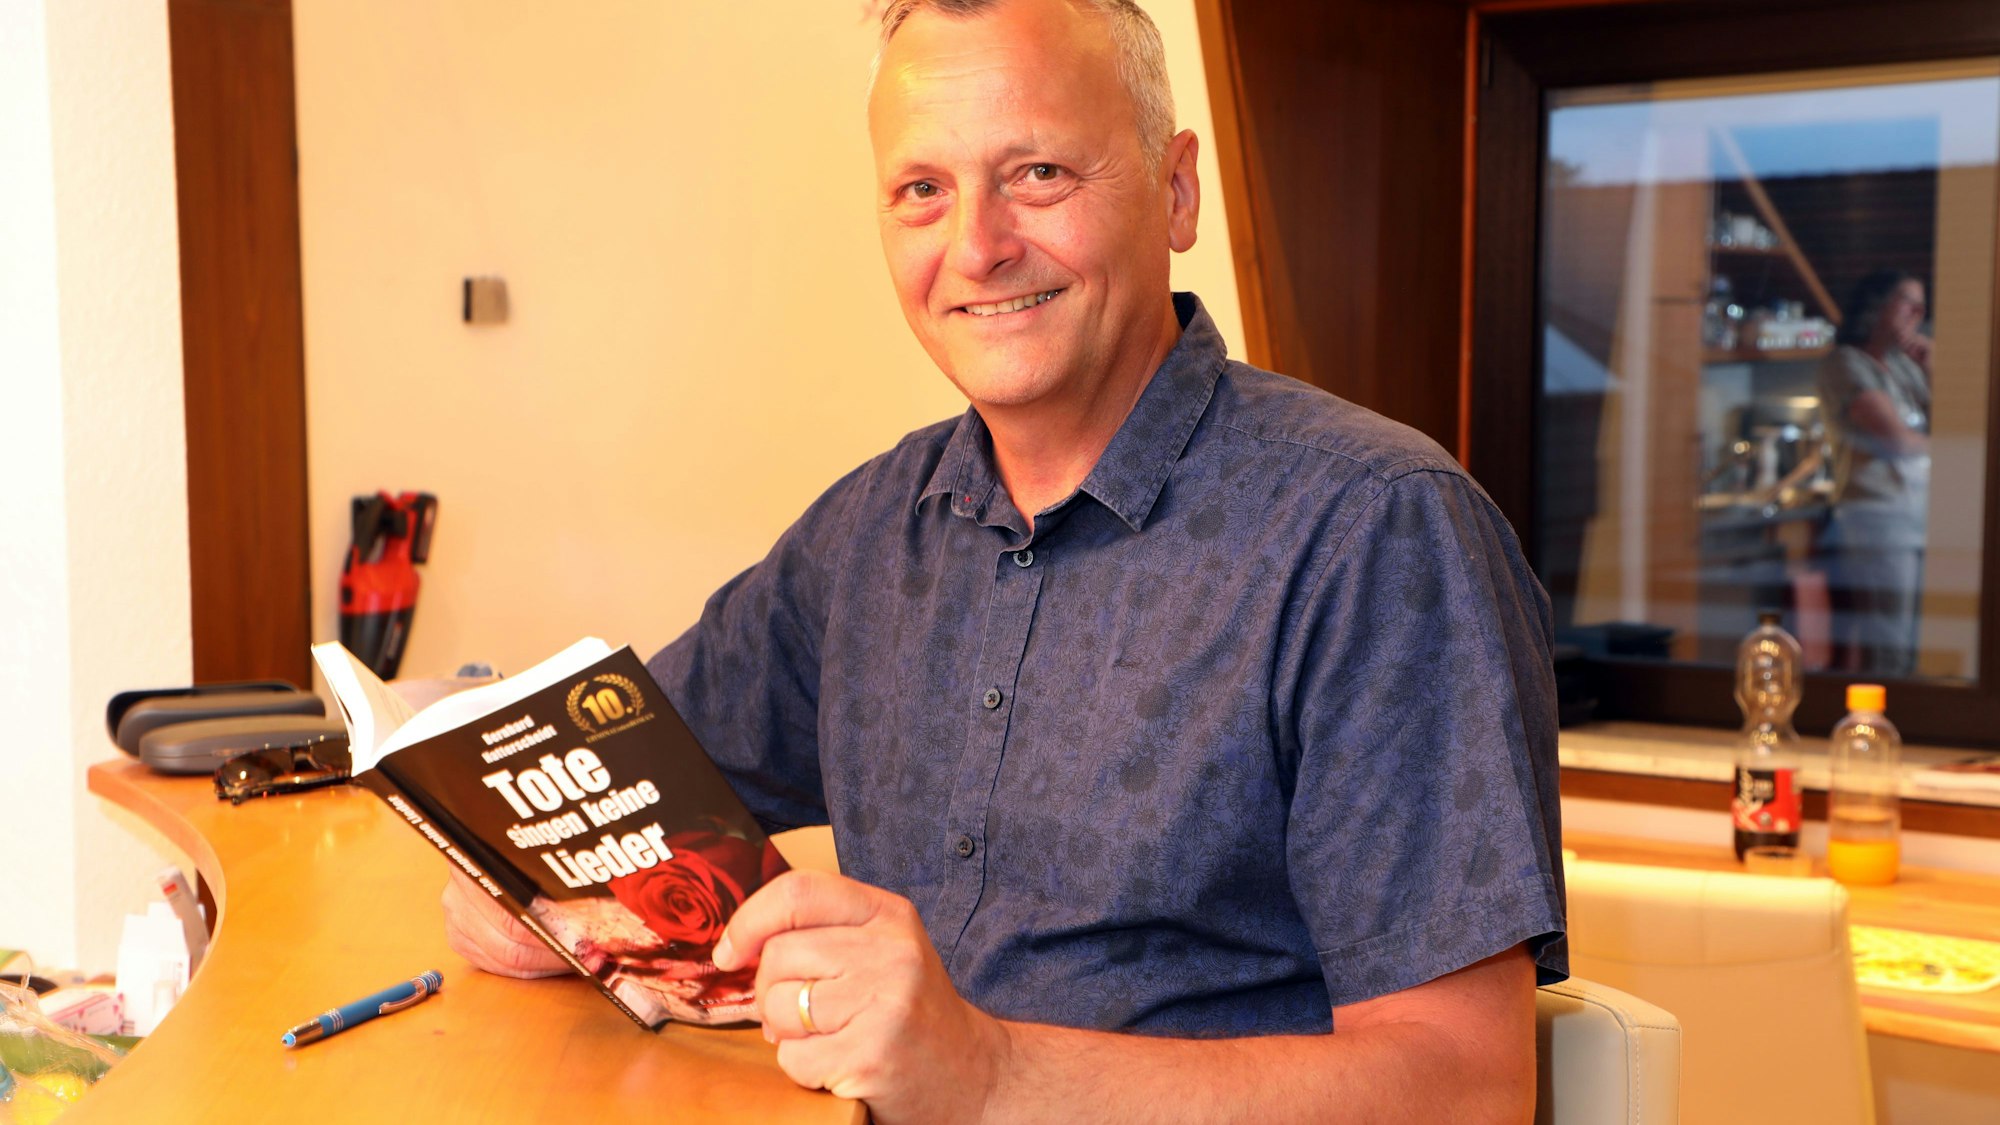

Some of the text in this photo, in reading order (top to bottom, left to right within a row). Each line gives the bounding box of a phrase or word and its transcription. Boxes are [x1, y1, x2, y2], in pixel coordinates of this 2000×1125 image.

[481, 714, 535, 746] Bernhard
[582, 687, 633, 725] 10.
[481, 747, 611, 819] Tote
[506, 780, 661, 849] singen keine
[387, 795, 503, 897] Tote singen keine Lieder
[540, 822, 674, 889] Lieder
